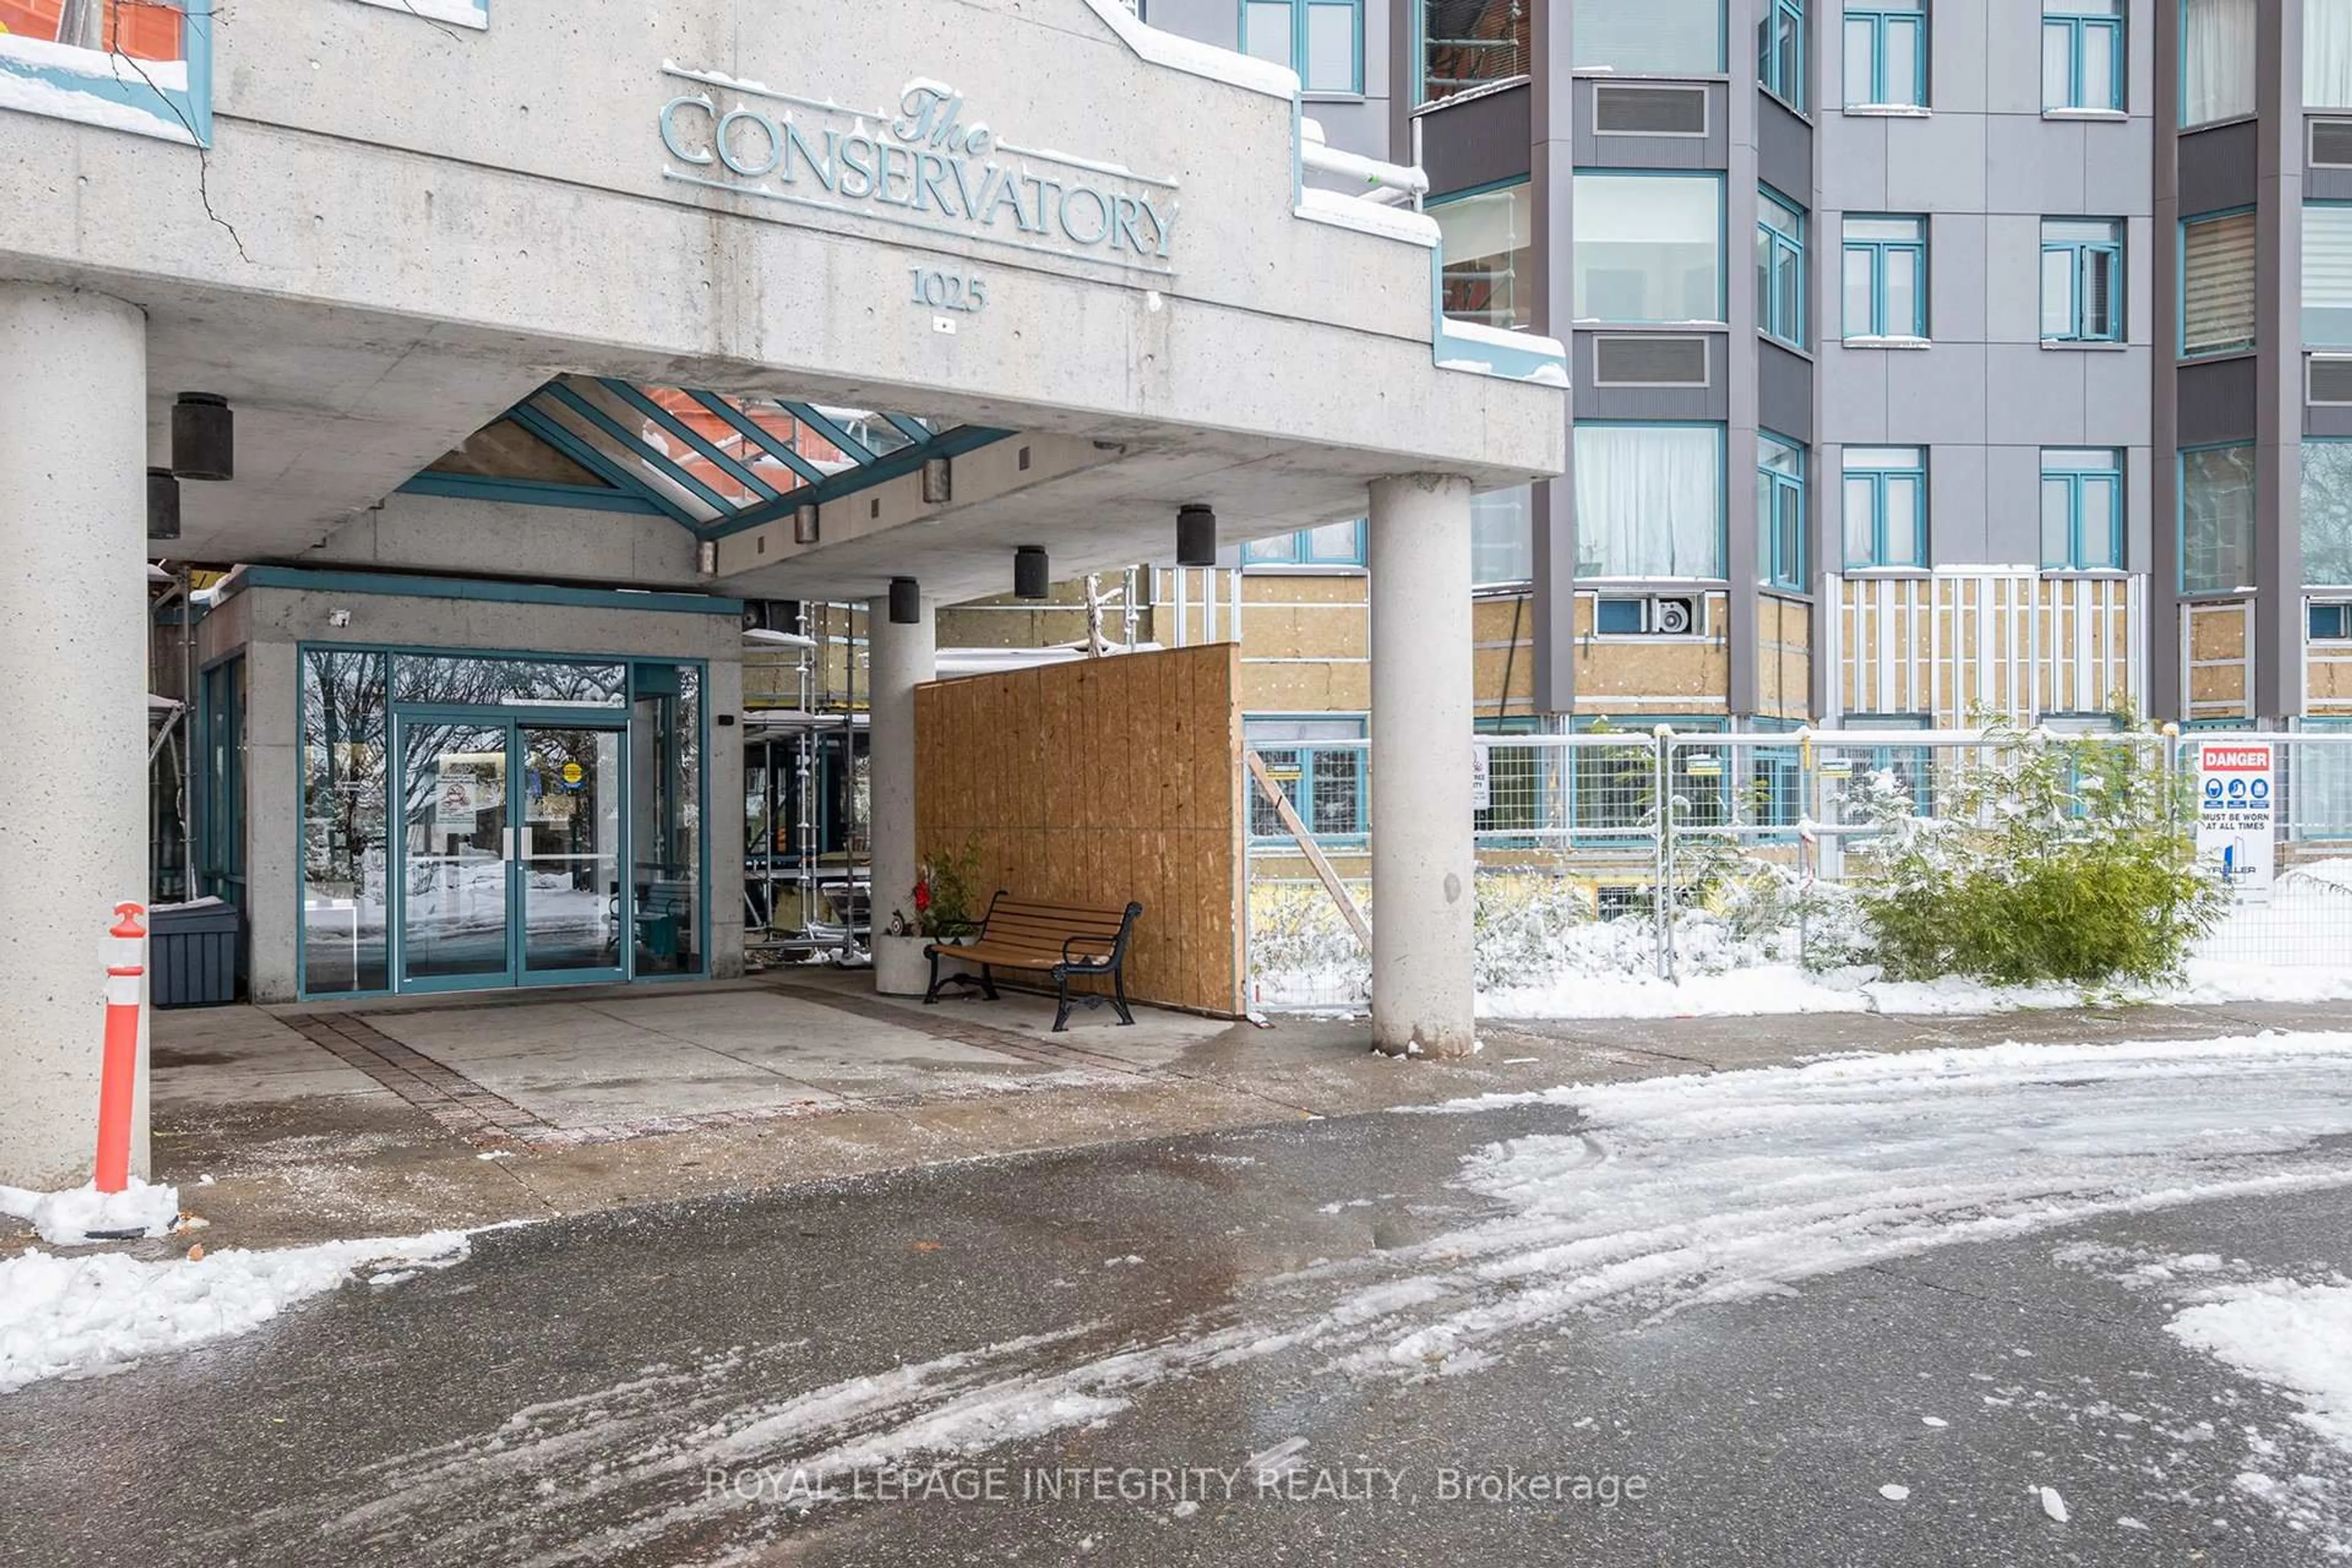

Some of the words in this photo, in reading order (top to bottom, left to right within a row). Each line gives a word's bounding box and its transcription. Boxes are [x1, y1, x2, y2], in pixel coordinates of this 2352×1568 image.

[892, 77, 991, 154] The
[660, 94, 1179, 258] CONSERVATORY
[909, 266, 990, 314] 1025
[2205, 752, 2267, 767] DANGER
